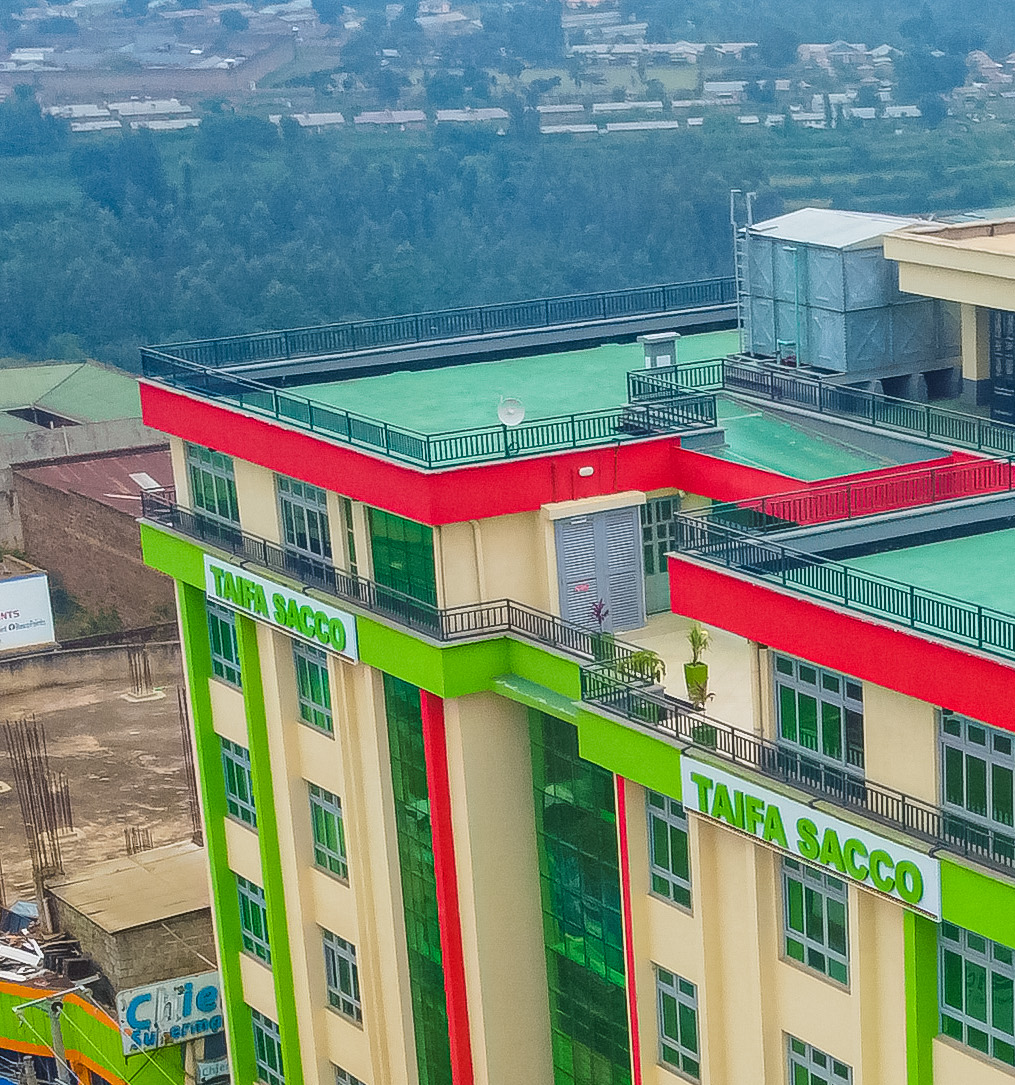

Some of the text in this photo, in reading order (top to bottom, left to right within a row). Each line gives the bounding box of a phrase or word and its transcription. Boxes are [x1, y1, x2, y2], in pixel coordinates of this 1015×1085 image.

[209, 564, 346, 651] TAIFA SACCO
[691, 771, 924, 904] TAIFA SACCO
